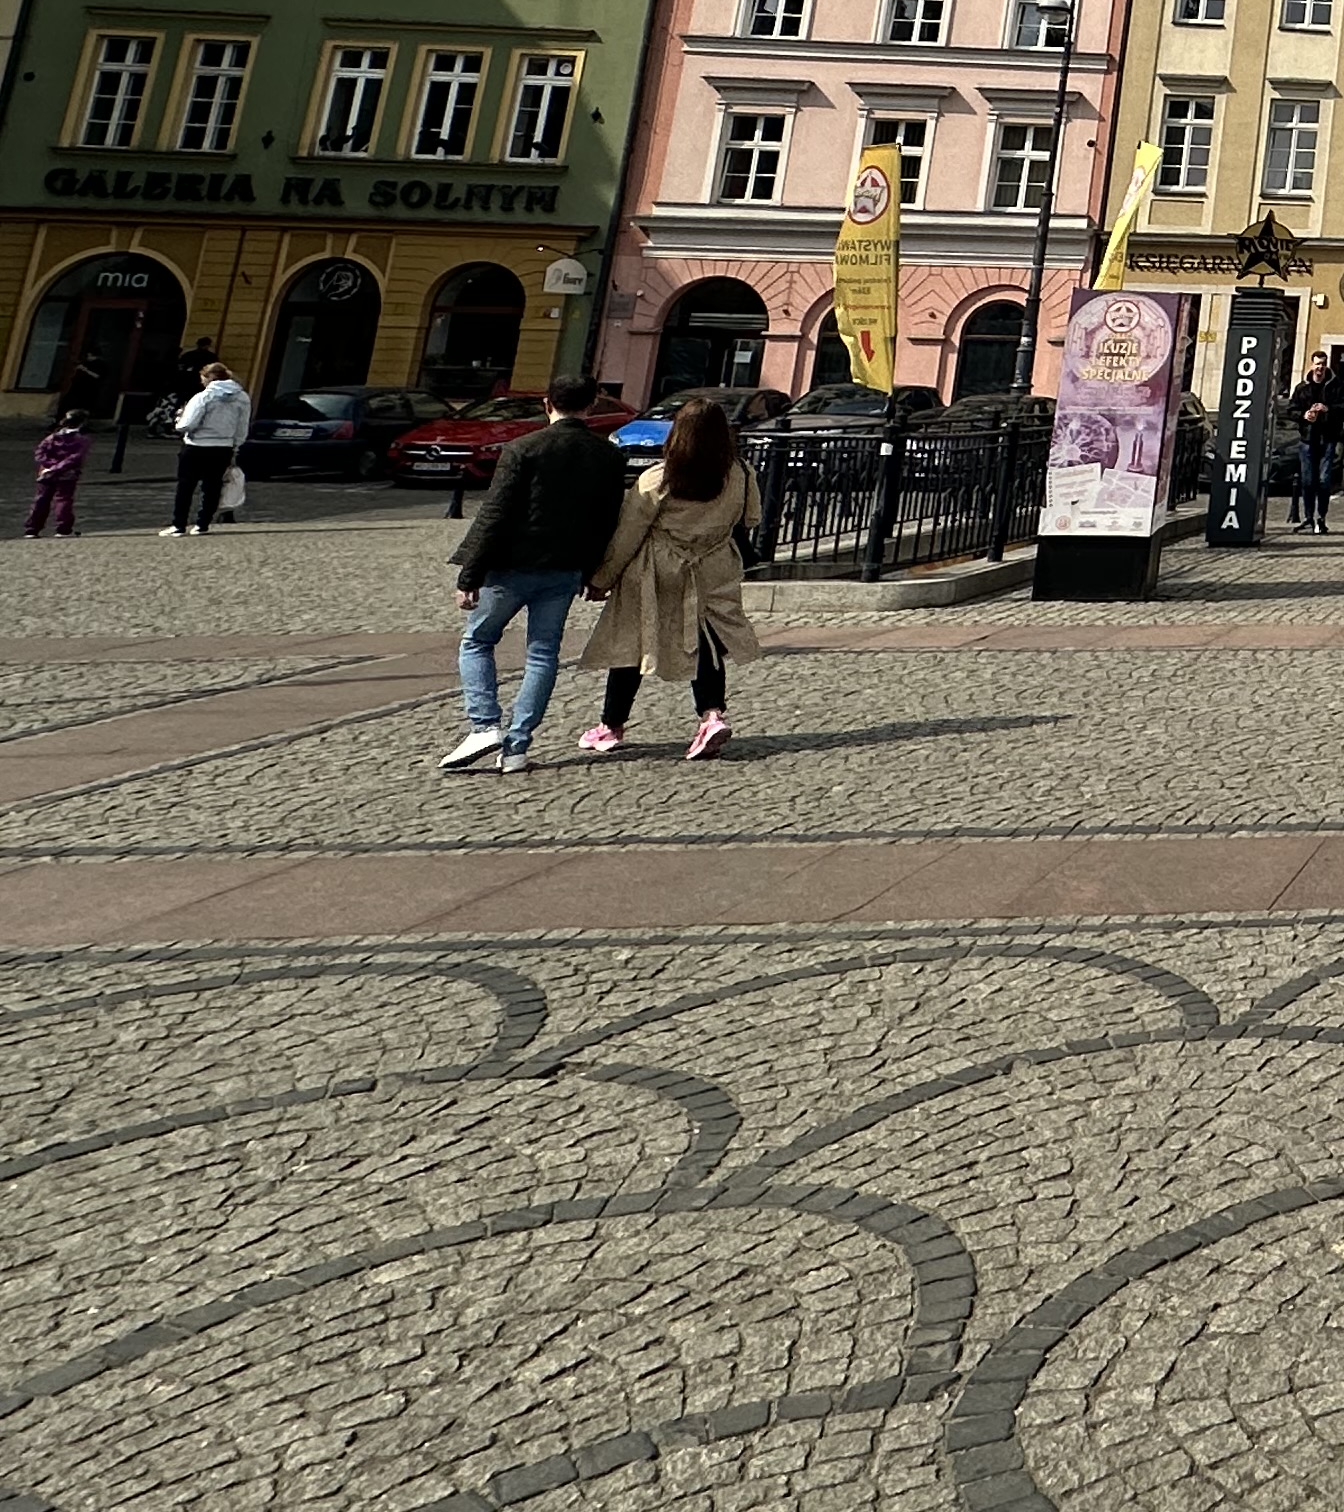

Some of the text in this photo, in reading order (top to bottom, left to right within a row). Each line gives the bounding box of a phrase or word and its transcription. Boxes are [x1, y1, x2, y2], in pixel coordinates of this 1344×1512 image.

[44, 167, 561, 213] GALERIA NA SOLNYM
[97, 272, 149, 288] mia
[1127, 252, 1245, 275] KSIĘGARN
[1220, 336, 1258, 530] PODZIEMIA
